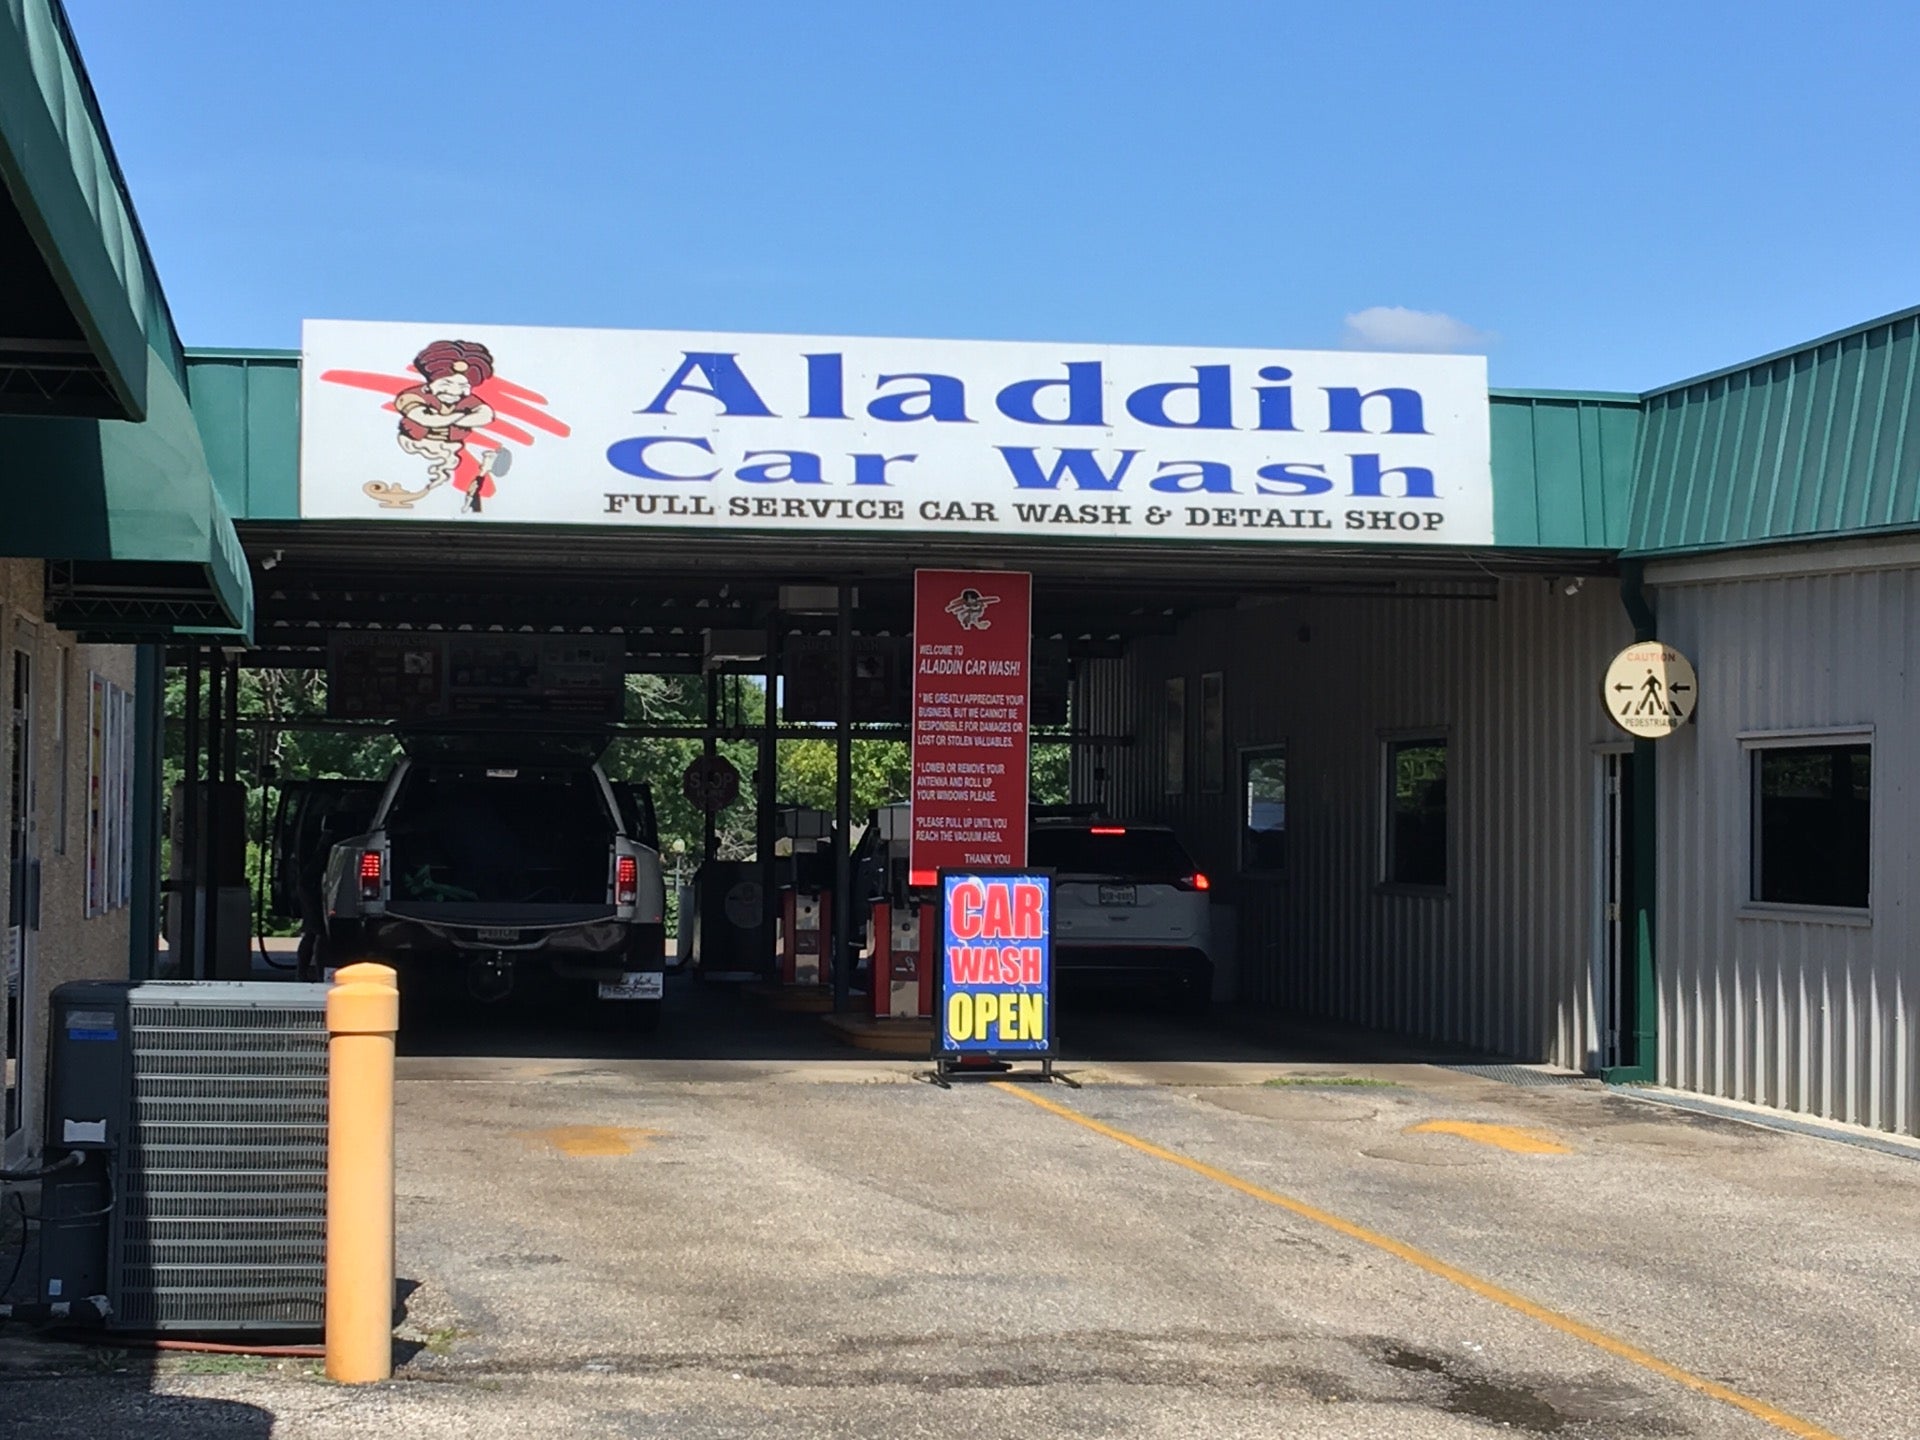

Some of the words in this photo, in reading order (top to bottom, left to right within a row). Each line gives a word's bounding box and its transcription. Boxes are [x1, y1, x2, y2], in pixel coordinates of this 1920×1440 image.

[632, 351, 1435, 435] Aladdin
[606, 435, 919, 486] Car
[991, 445, 1444, 499] Wash
[603, 493, 715, 516] FULL
[728, 497, 904, 519] SERVICE
[919, 500, 999, 522] CAR
[1013, 503, 1131, 525] WASH
[1145, 505, 1172, 526] &
[1185, 507, 1332, 529] DETAIL
[1345, 510, 1445, 532] SHOP
[919, 644, 952, 655] WELCOME
[954, 645, 964, 656] TO
[1627, 652, 1676, 662] CAUTION
[919, 658, 962, 675] ALADDIN
[965, 660, 986, 675] CAR
[988, 660, 1020, 676] WASH!
[922, 693, 933, 704] WE
[935, 693, 964, 704] GREATLY
[964, 693, 1004, 705] APPRECIATE
[1005, 695, 1024, 705] YOUR
[954, 708, 967, 718] BUT
[968, 708, 978, 718] WE
[980, 708, 1007, 719] CANNOT
[1008, 708, 1018, 719] BE
[918, 720, 963, 731] RESPONSIBLE
[965, 722, 978, 732] FOR
[980, 722, 1011, 732] DAMAGES
[1012, 722, 1023, 733] OR
[917, 735, 935, 745] LOST
[936, 735, 946, 746] OR
[947, 736, 973, 746] STOLEN
[921, 762, 945, 773] LOWER
[946, 763, 956, 773] OR
[957, 763, 985, 774] REMOVE
[986, 764, 1005, 774] YOUR
[689, 771, 733, 789] SOP
[949, 776, 963, 787] AND
[964, 777, 982, 787] ROLL
[983, 777, 993, 788] UP
[917, 790, 935, 800] YOUR
[936, 790, 968, 800] WINDOWS
[945, 817, 962, 828] PULL
[963, 817, 972, 828] UP
[974, 818, 993, 828] UNTIL
[993, 818, 1007, 829] YOU
[916, 830, 939, 841] REACH
[940, 831, 953, 841] THE
[953, 831, 981, 841] VACUUM
[964, 853, 991, 864] THANK
[993, 854, 1011, 865] YOU
[951, 882, 1043, 940] CAR
[951, 945, 1042, 985] WASH
[948, 992, 1043, 1041] OPEN
